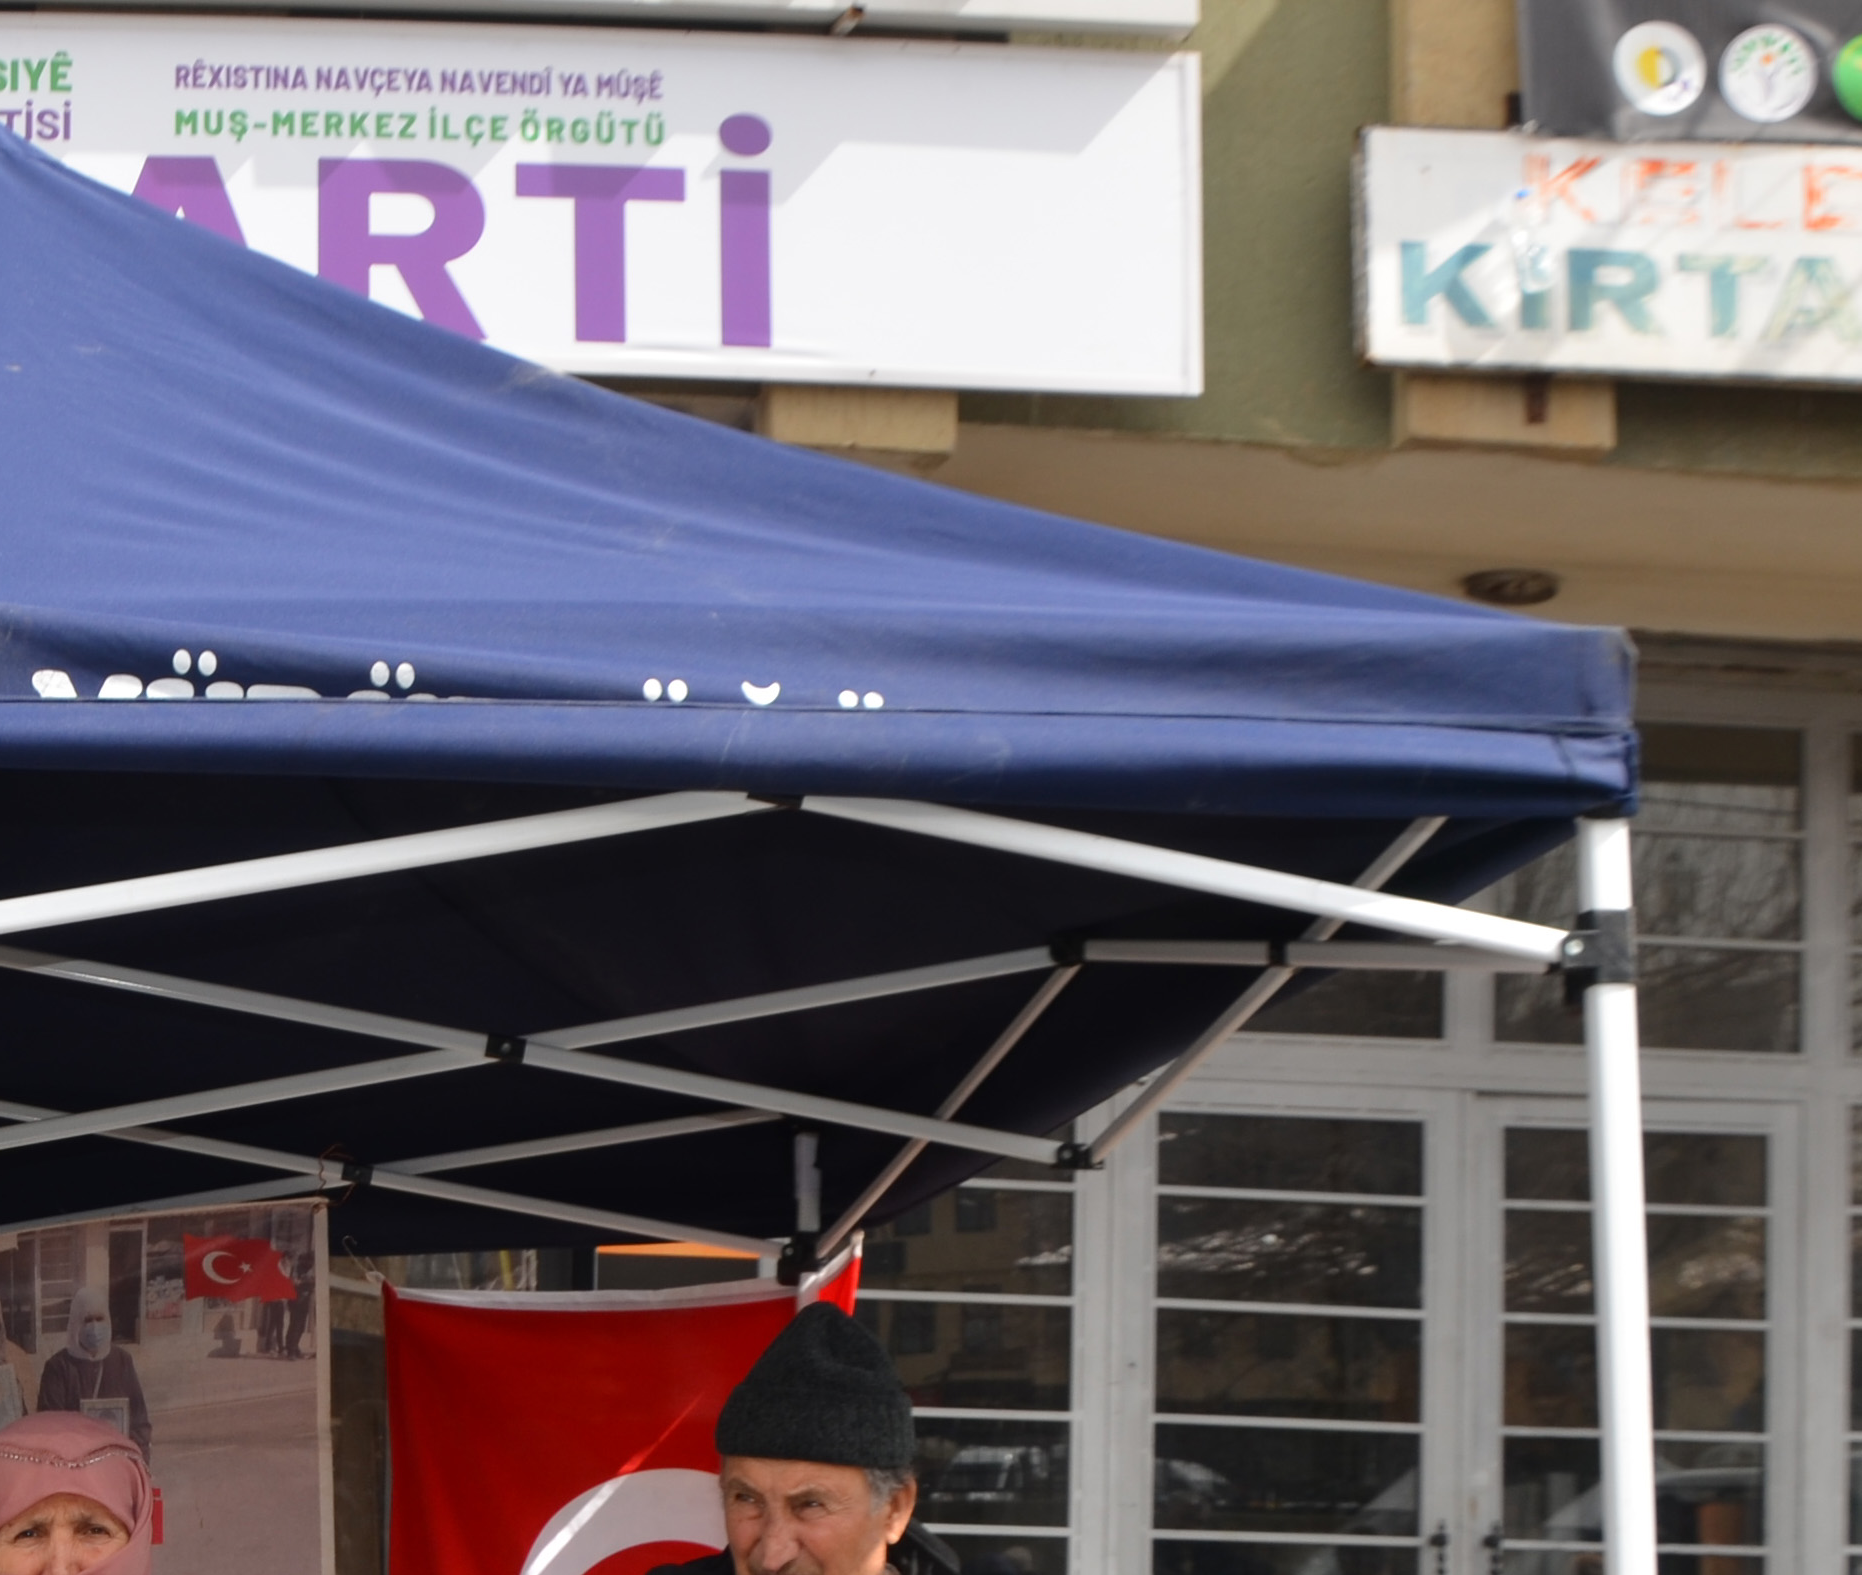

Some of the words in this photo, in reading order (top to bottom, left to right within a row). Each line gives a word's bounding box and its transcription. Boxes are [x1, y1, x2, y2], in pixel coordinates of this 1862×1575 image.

[316, 65, 433, 98] NAVÇEYA
[559, 71, 589, 97] YA
[175, 108, 418, 143] MUŞ-MERKEZ
[429, 105, 509, 147] İLÇE
[521, 107, 665, 147] ÖRGÜTÜ
